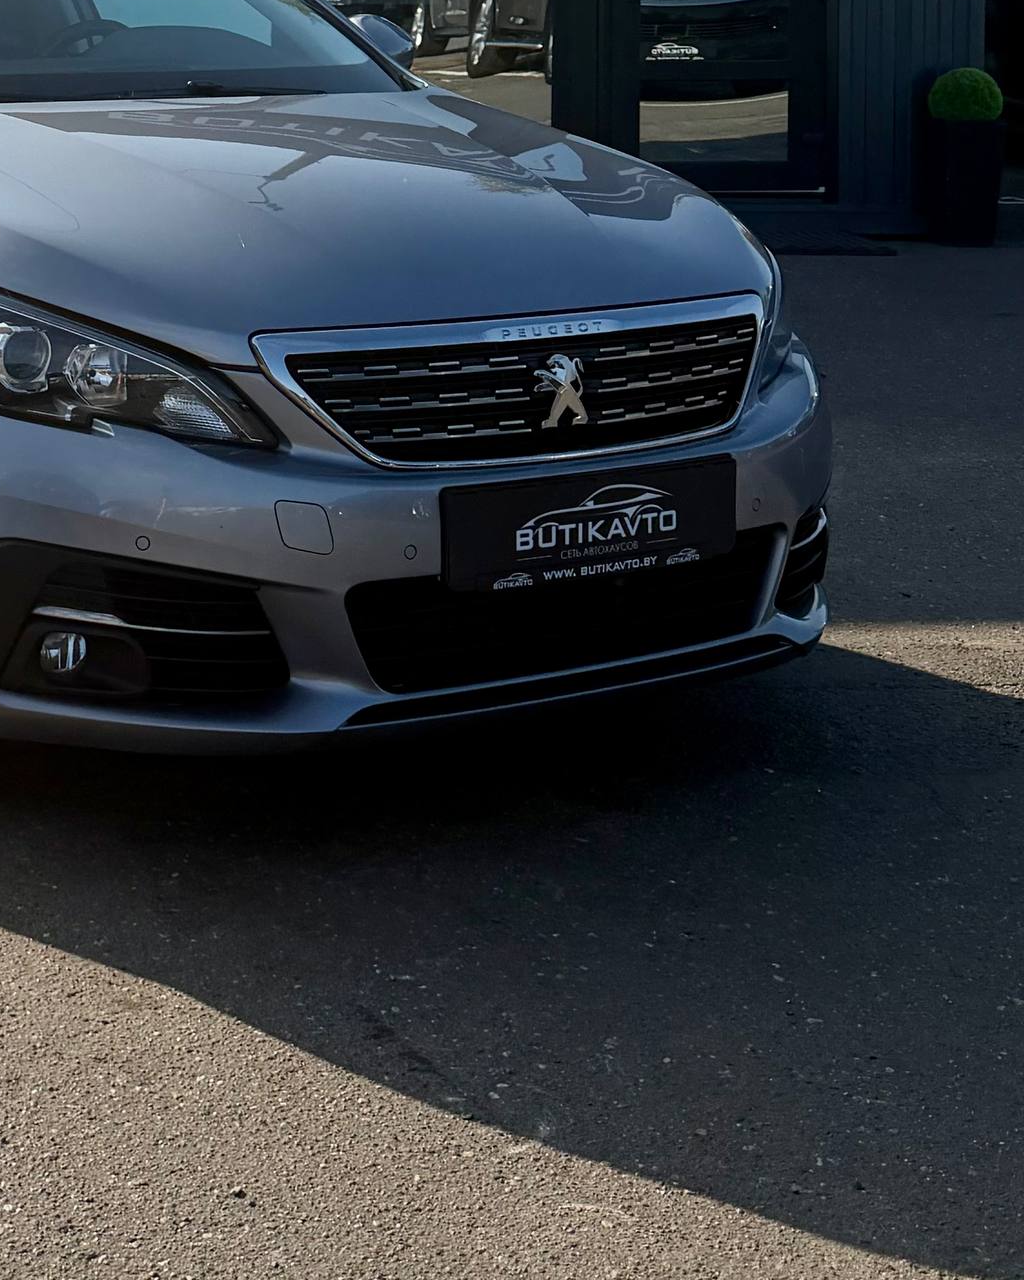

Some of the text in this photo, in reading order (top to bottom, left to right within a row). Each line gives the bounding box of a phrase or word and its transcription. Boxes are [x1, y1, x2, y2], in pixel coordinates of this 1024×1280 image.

[501, 321, 602, 339] PEUGEOT
[516, 509, 677, 551] BUTIKAVTO
[580, 555, 658, 576] BUTIKAVTO.BY
[493, 578, 533, 590] BUTIKAVTO
